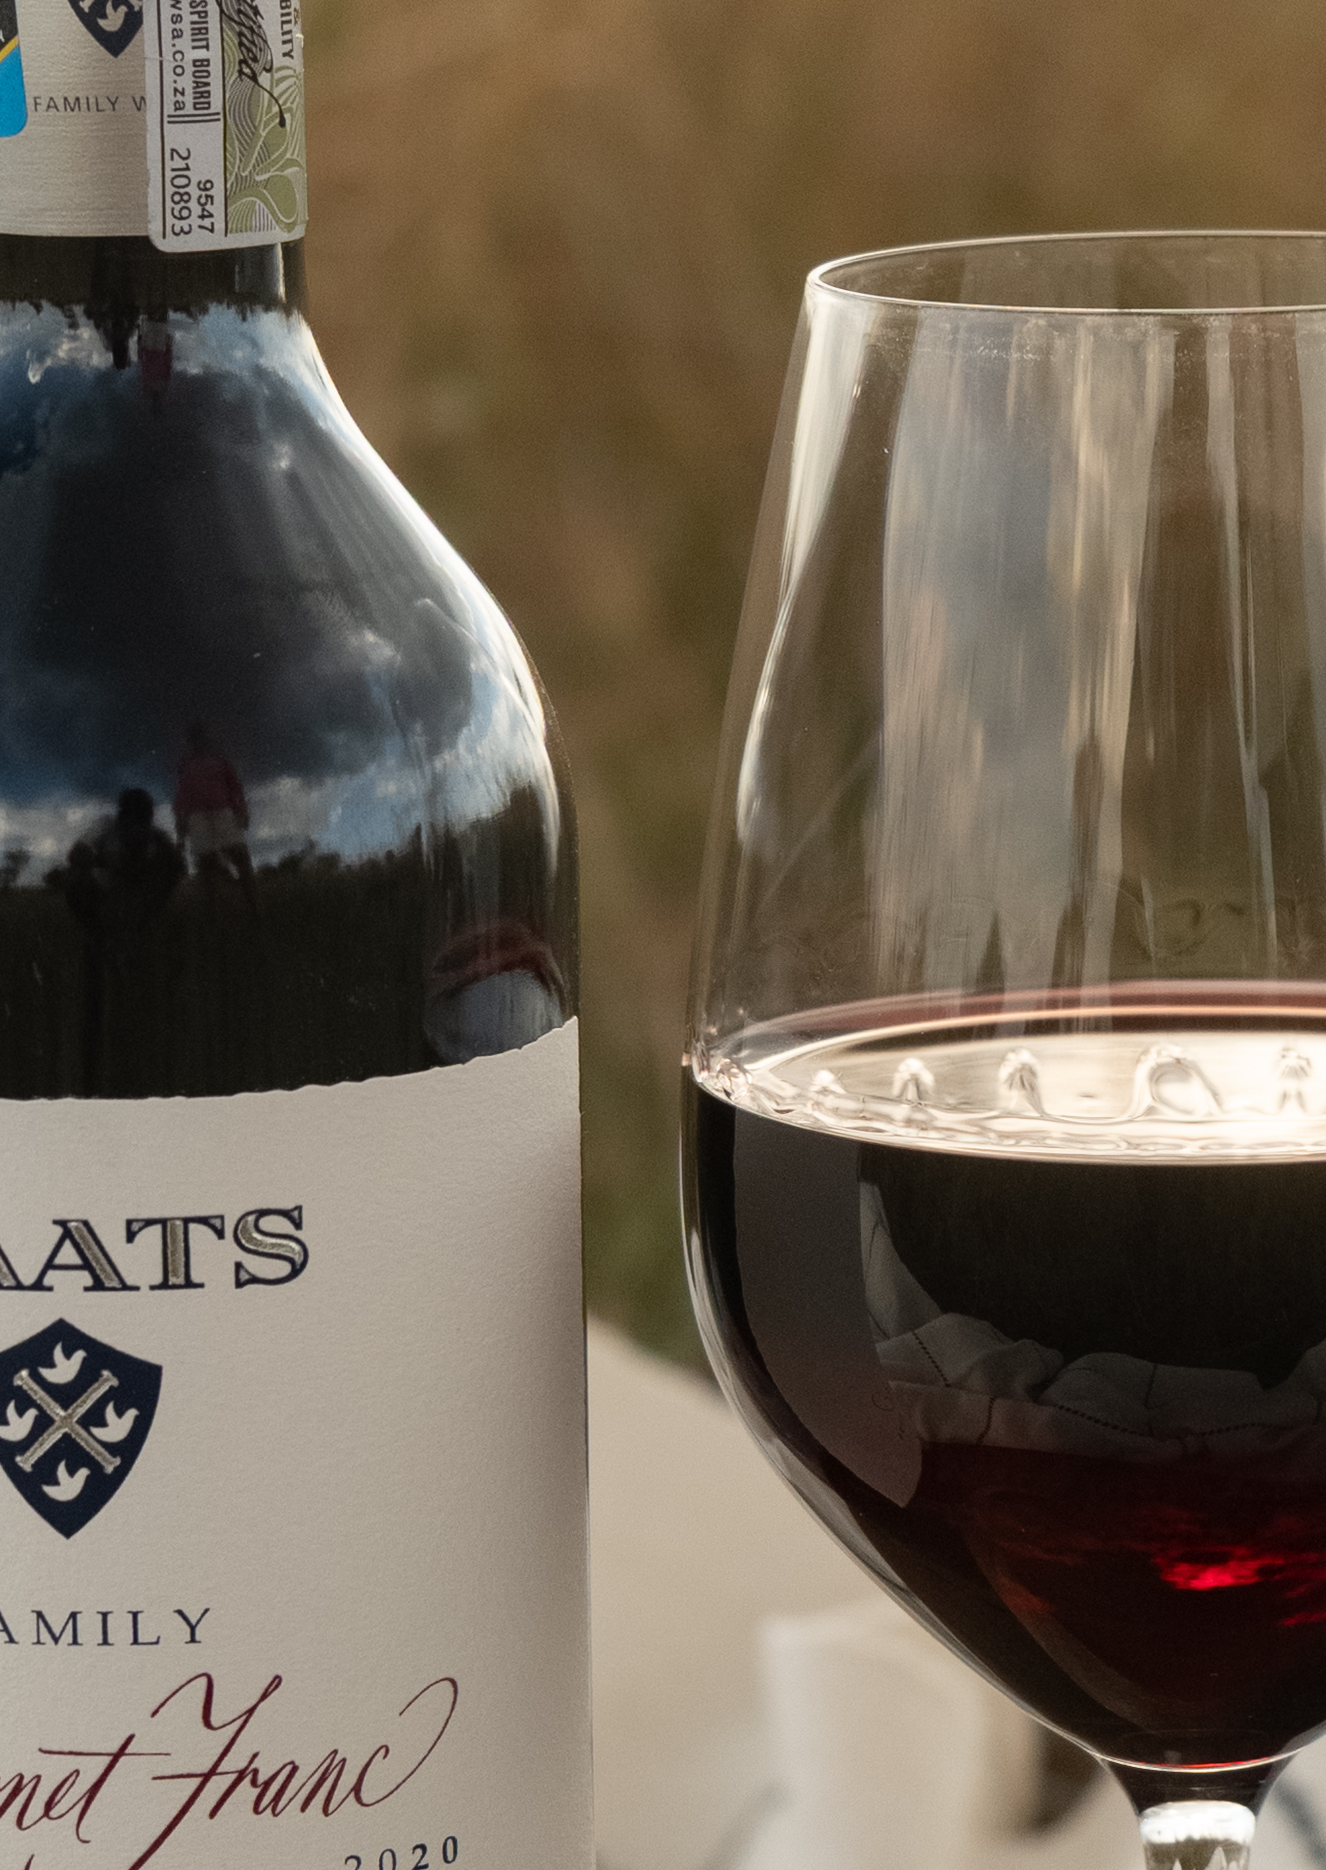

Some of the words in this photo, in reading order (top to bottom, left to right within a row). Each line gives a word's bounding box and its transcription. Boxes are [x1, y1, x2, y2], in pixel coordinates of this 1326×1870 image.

[189, 0, 210, 51] SPIRIT
[33, 96, 119, 112] FAMILY
[192, 59, 211, 111] BOARD
[170, 148, 192, 237] 210893
[197, 179, 215, 234] 9547
